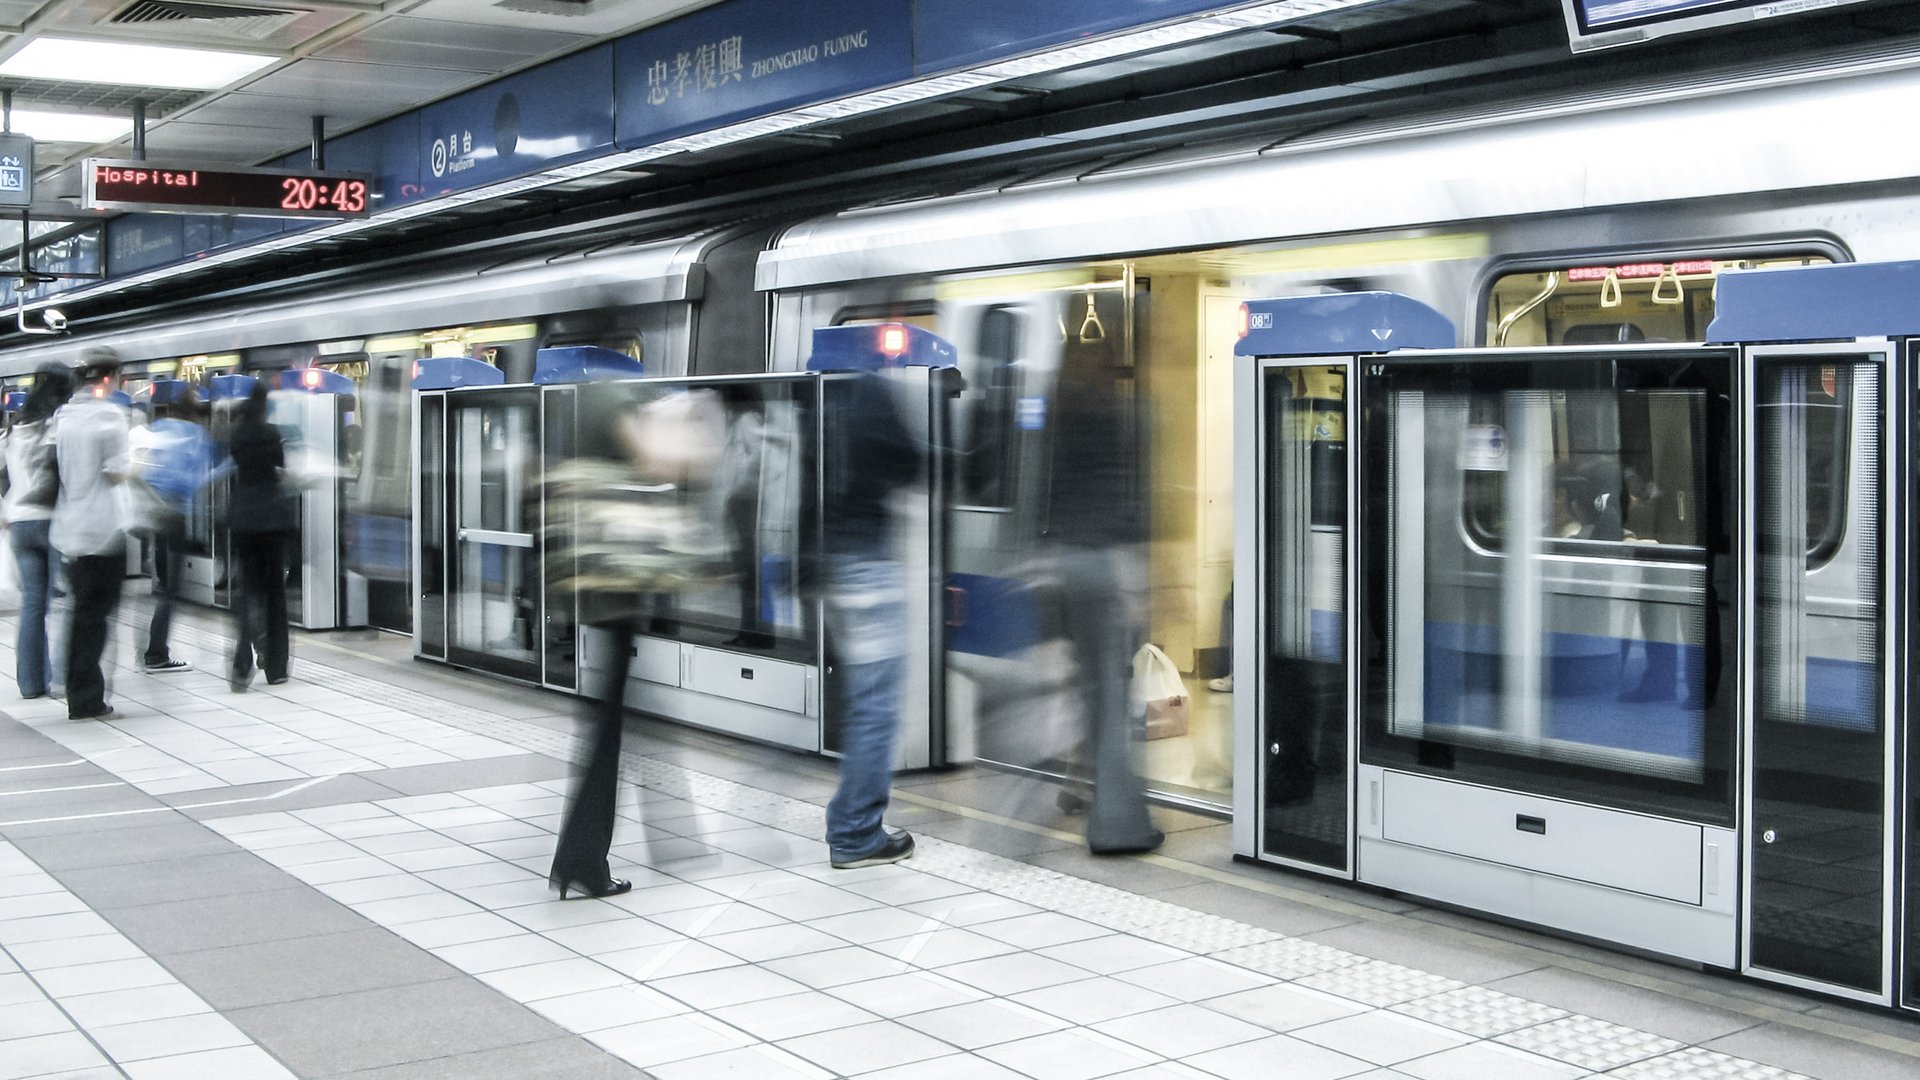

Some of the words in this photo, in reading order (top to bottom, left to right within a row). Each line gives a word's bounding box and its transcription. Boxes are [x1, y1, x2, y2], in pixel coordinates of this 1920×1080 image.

[646, 35, 743, 105] 忠孝復興
[751, 45, 818, 78] ZHONGXIAO
[824, 30, 868, 57] FUXING
[449, 130, 472, 157] 月台
[95, 166, 197, 186] Hospital
[281, 178, 365, 212] 20:43
[1251, 314, 1264, 328] 08
